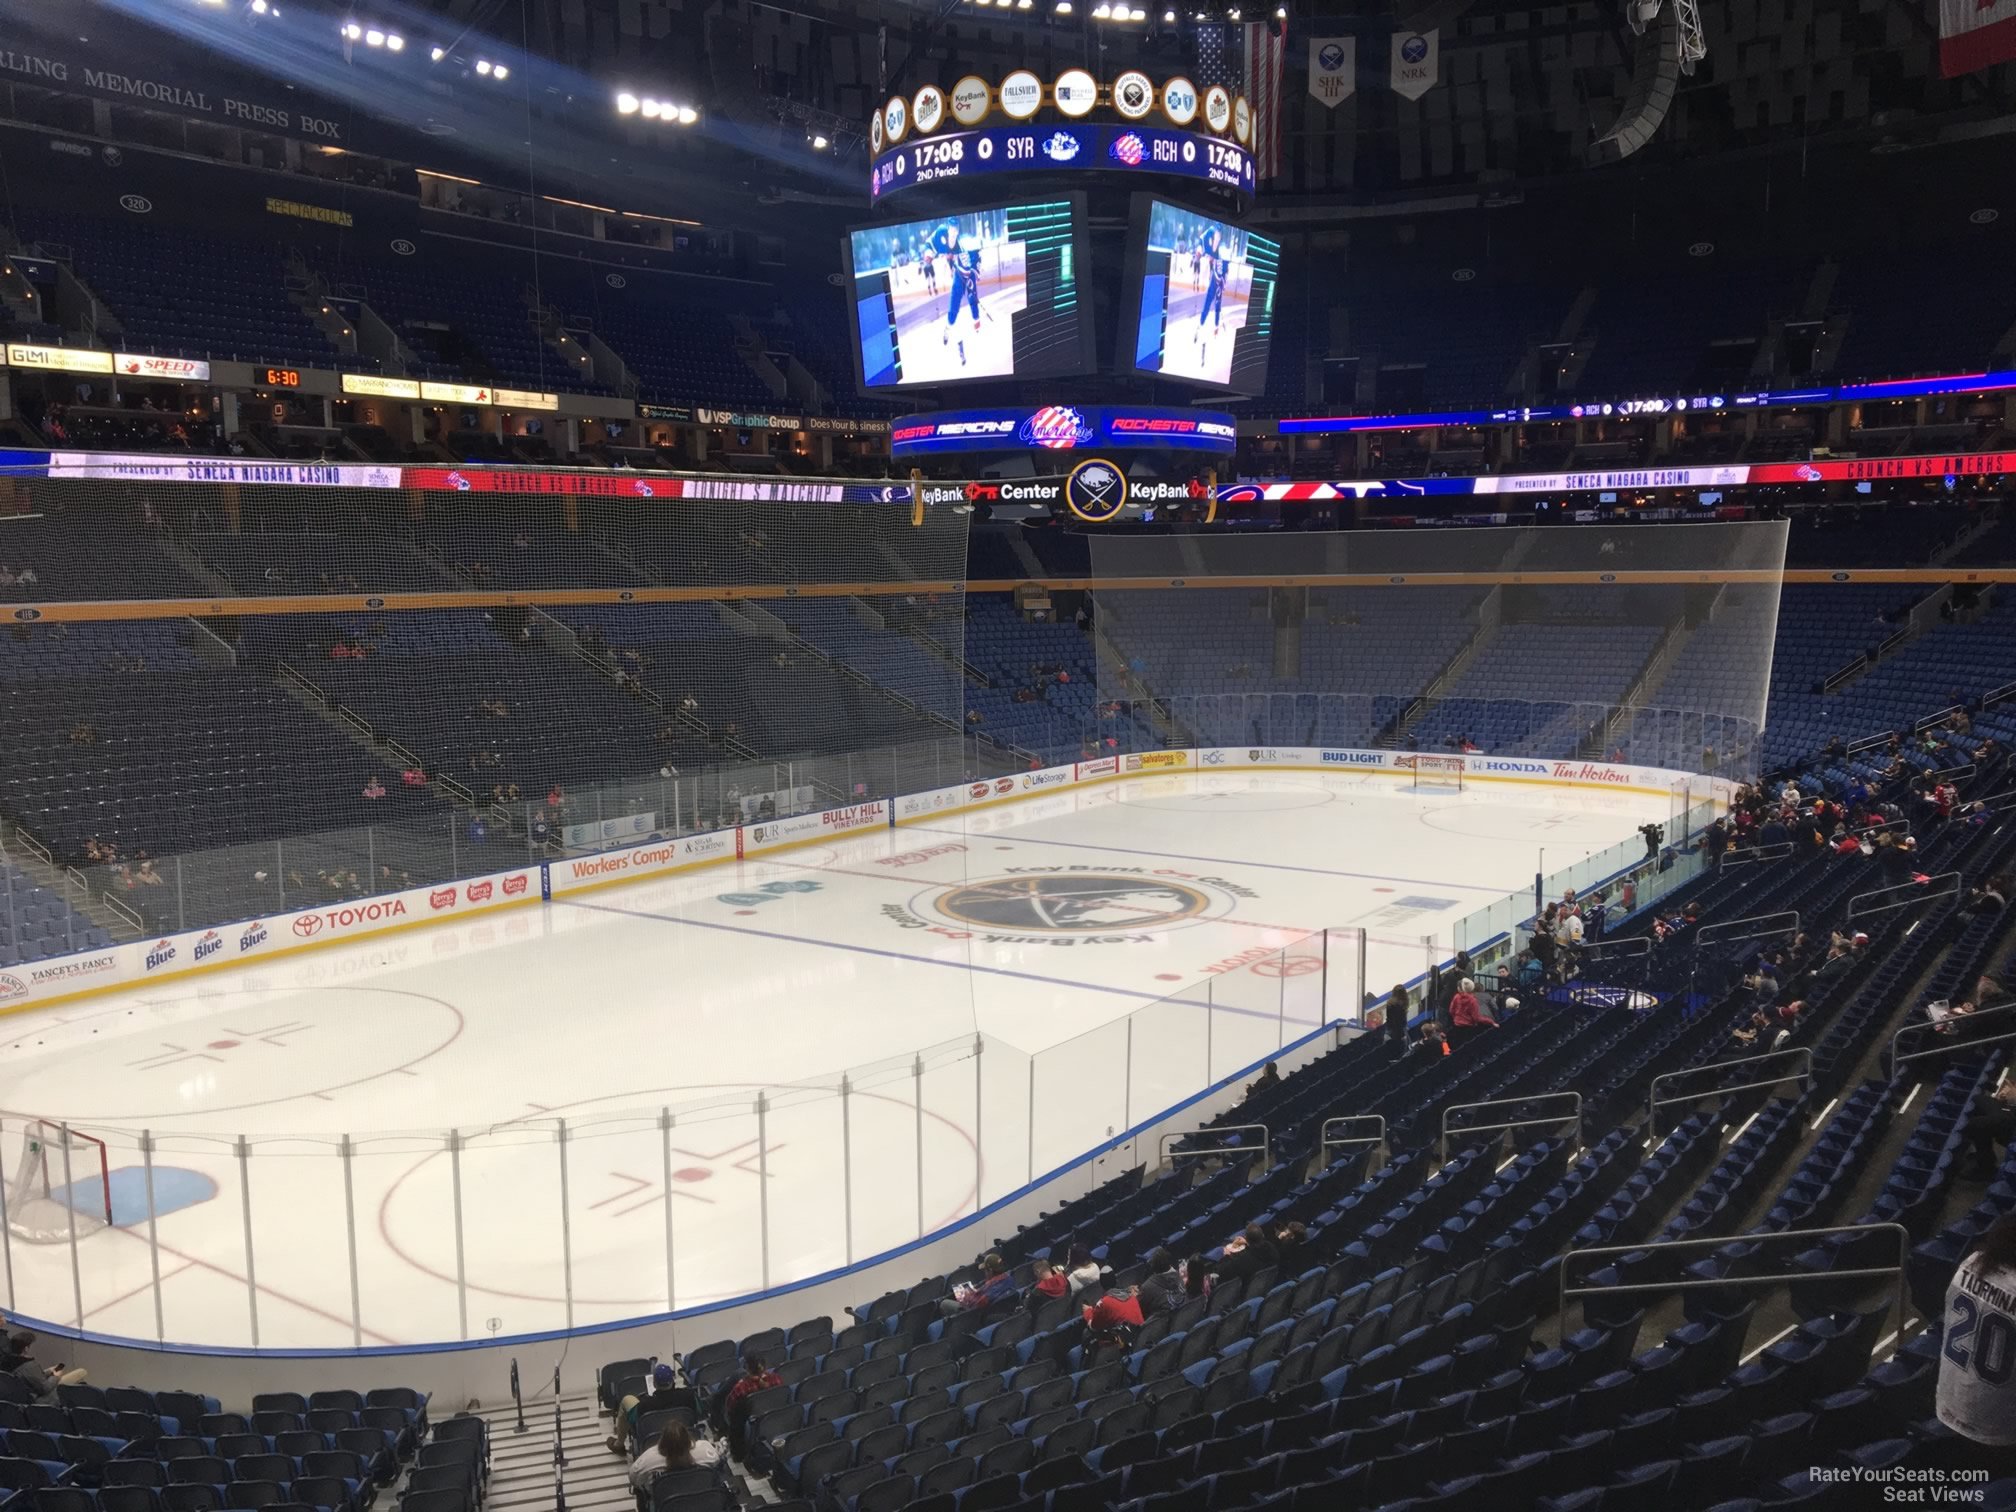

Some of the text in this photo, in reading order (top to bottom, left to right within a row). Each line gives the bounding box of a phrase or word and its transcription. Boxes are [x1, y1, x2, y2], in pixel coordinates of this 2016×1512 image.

[1318, 75, 1345, 87] SHK
[1400, 67, 1427, 80] NRK
[84, 68, 212, 112] MEMORIAL
[224, 99, 289, 127] PRESS
[301, 116, 341, 139] BOX
[955, 91, 986, 104] KeyBank
[915, 140, 963, 167] 17:08
[978, 137, 1034, 159] 0 SYR
[1154, 139, 1177, 162] RCH
[1183, 141, 1196, 162] 0
[896, 154, 905, 175] 0
[1208, 144, 1242, 172] 17:08
[917, 163, 959, 181] 2ND Period
[1209, 168, 1239, 185] 2ND Period
[128, 199, 144, 209] 320
[13, 349, 49, 364] GLMI
[144, 360, 194, 371] SPEED
[267, 370, 298, 386] 6:30
[1586, 404, 1612, 415] RCH 0
[1627, 400, 1664, 413] 17:08
[1677, 398, 1708, 410] 0 SYR
[811, 418, 830, 430] Does
[831, 420, 848, 430] Your
[850, 420, 885, 432] Business
[1111, 419, 1196, 431] ROCHESTER
[188, 461, 235, 481] SENECA
[242, 465, 293, 483] NIAGARA
[301, 466, 340, 484] CASINO
[1848, 461, 1903, 478] CRUNCH
[1915, 459, 1932, 475] VS
[1515, 479, 1547, 489] PRESENTED
[1566, 474, 1600, 489] SENECA
[1607, 472, 1648, 488] NIAGARA
[1654, 471, 1690, 485] CASINO
[921, 484, 1059, 506] KeyBank Center
[1131, 482, 1190, 503] KeyBank
[1261, 750, 1276, 760] UR
[1323, 752, 1383, 764] BUD LIGHT
[1486, 761, 1548, 773] HONDA
[1553, 762, 1577, 778] Tim
[1579, 764, 1631, 784] Hortons
[823, 807, 857, 824] BULLY
[860, 802, 884, 818] HILL
[764, 824, 779, 838] UR
[833, 816, 874, 830] VINEYARDS
[572, 844, 675, 878] Workers' Comp?
[327, 900, 406, 928] TOYOTA
[194, 938, 222, 961] Blue
[240, 929, 268, 952] Blue
[32, 962, 80, 980] YANCEY'S
[82, 956, 115, 970] FANCY
[146, 947, 176, 971] Blue
[1943, 1292, 2016, 1386] 20
